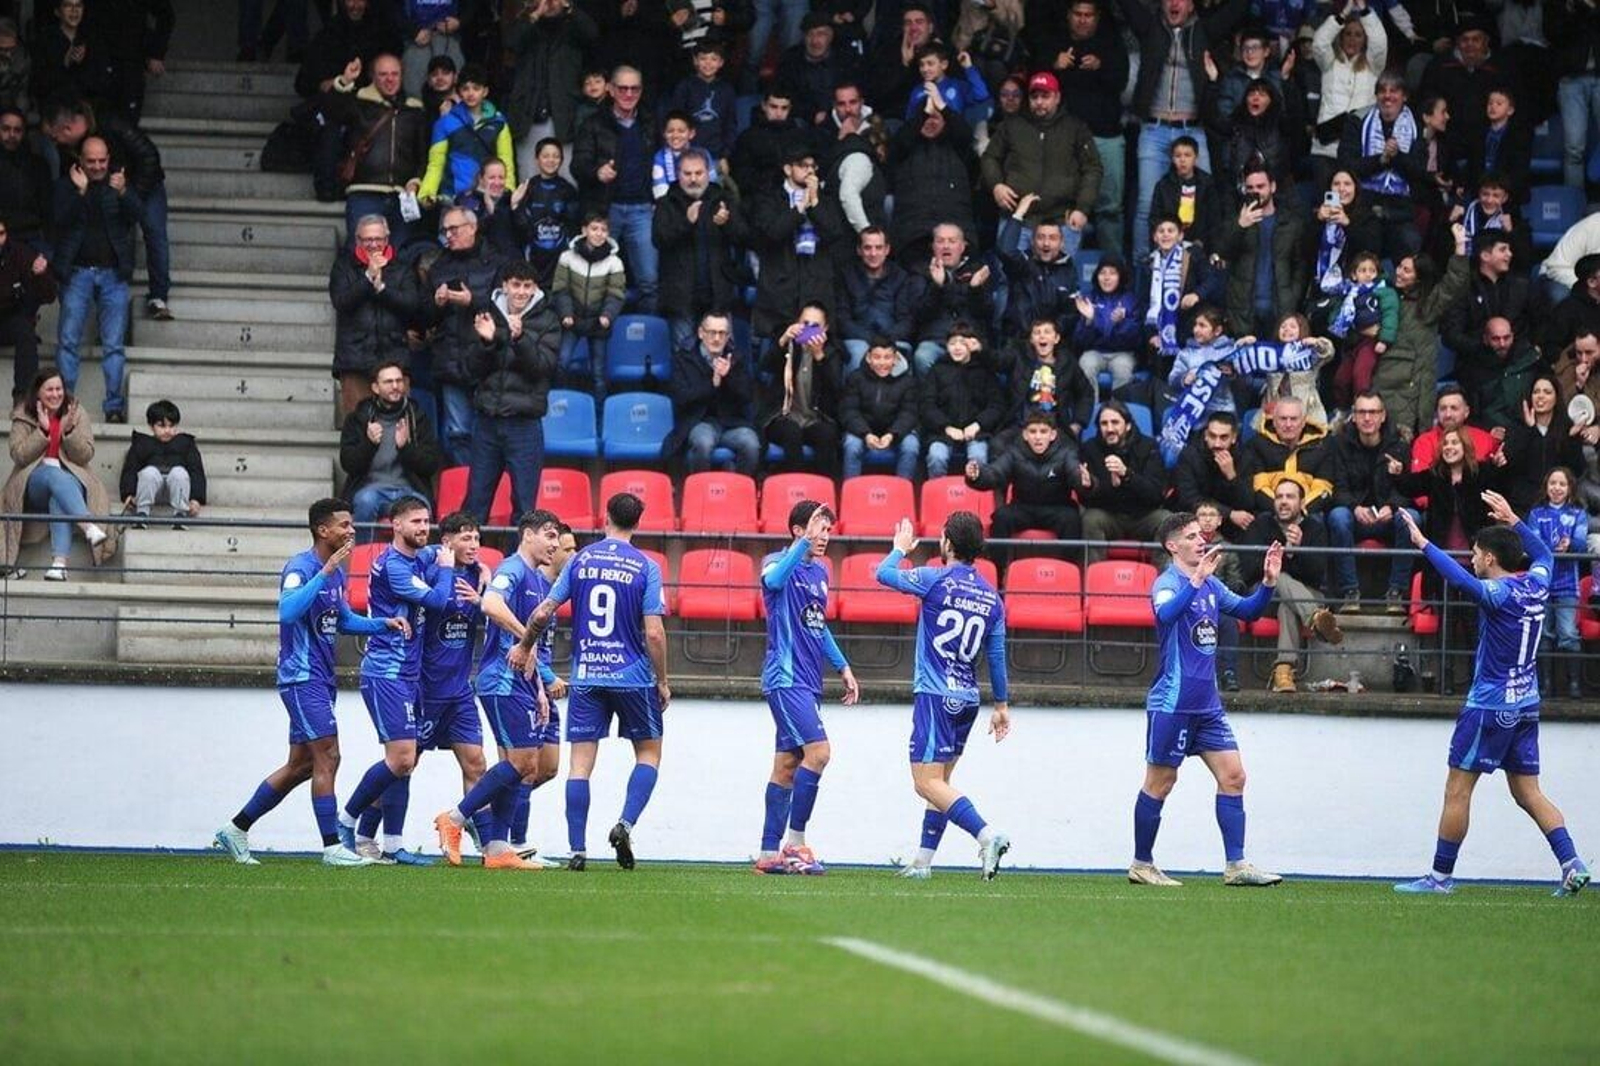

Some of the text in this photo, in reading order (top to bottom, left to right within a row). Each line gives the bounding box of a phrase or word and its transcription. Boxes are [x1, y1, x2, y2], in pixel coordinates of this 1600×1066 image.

[244, 152, 254, 168] 7
[241, 227, 253, 242] 6
[240, 327, 251, 342] 5
[236, 380, 248, 394] 4
[235, 458, 248, 473] 3
[227, 537, 239, 552] 2
[601, 568, 633, 585] RENZO
[588, 584, 616, 638] 9
[933, 609, 986, 662] 20
[1518, 613, 1546, 666] 17
[580, 652, 625, 664] ABANCA
[1177, 729, 1188, 750] 5
